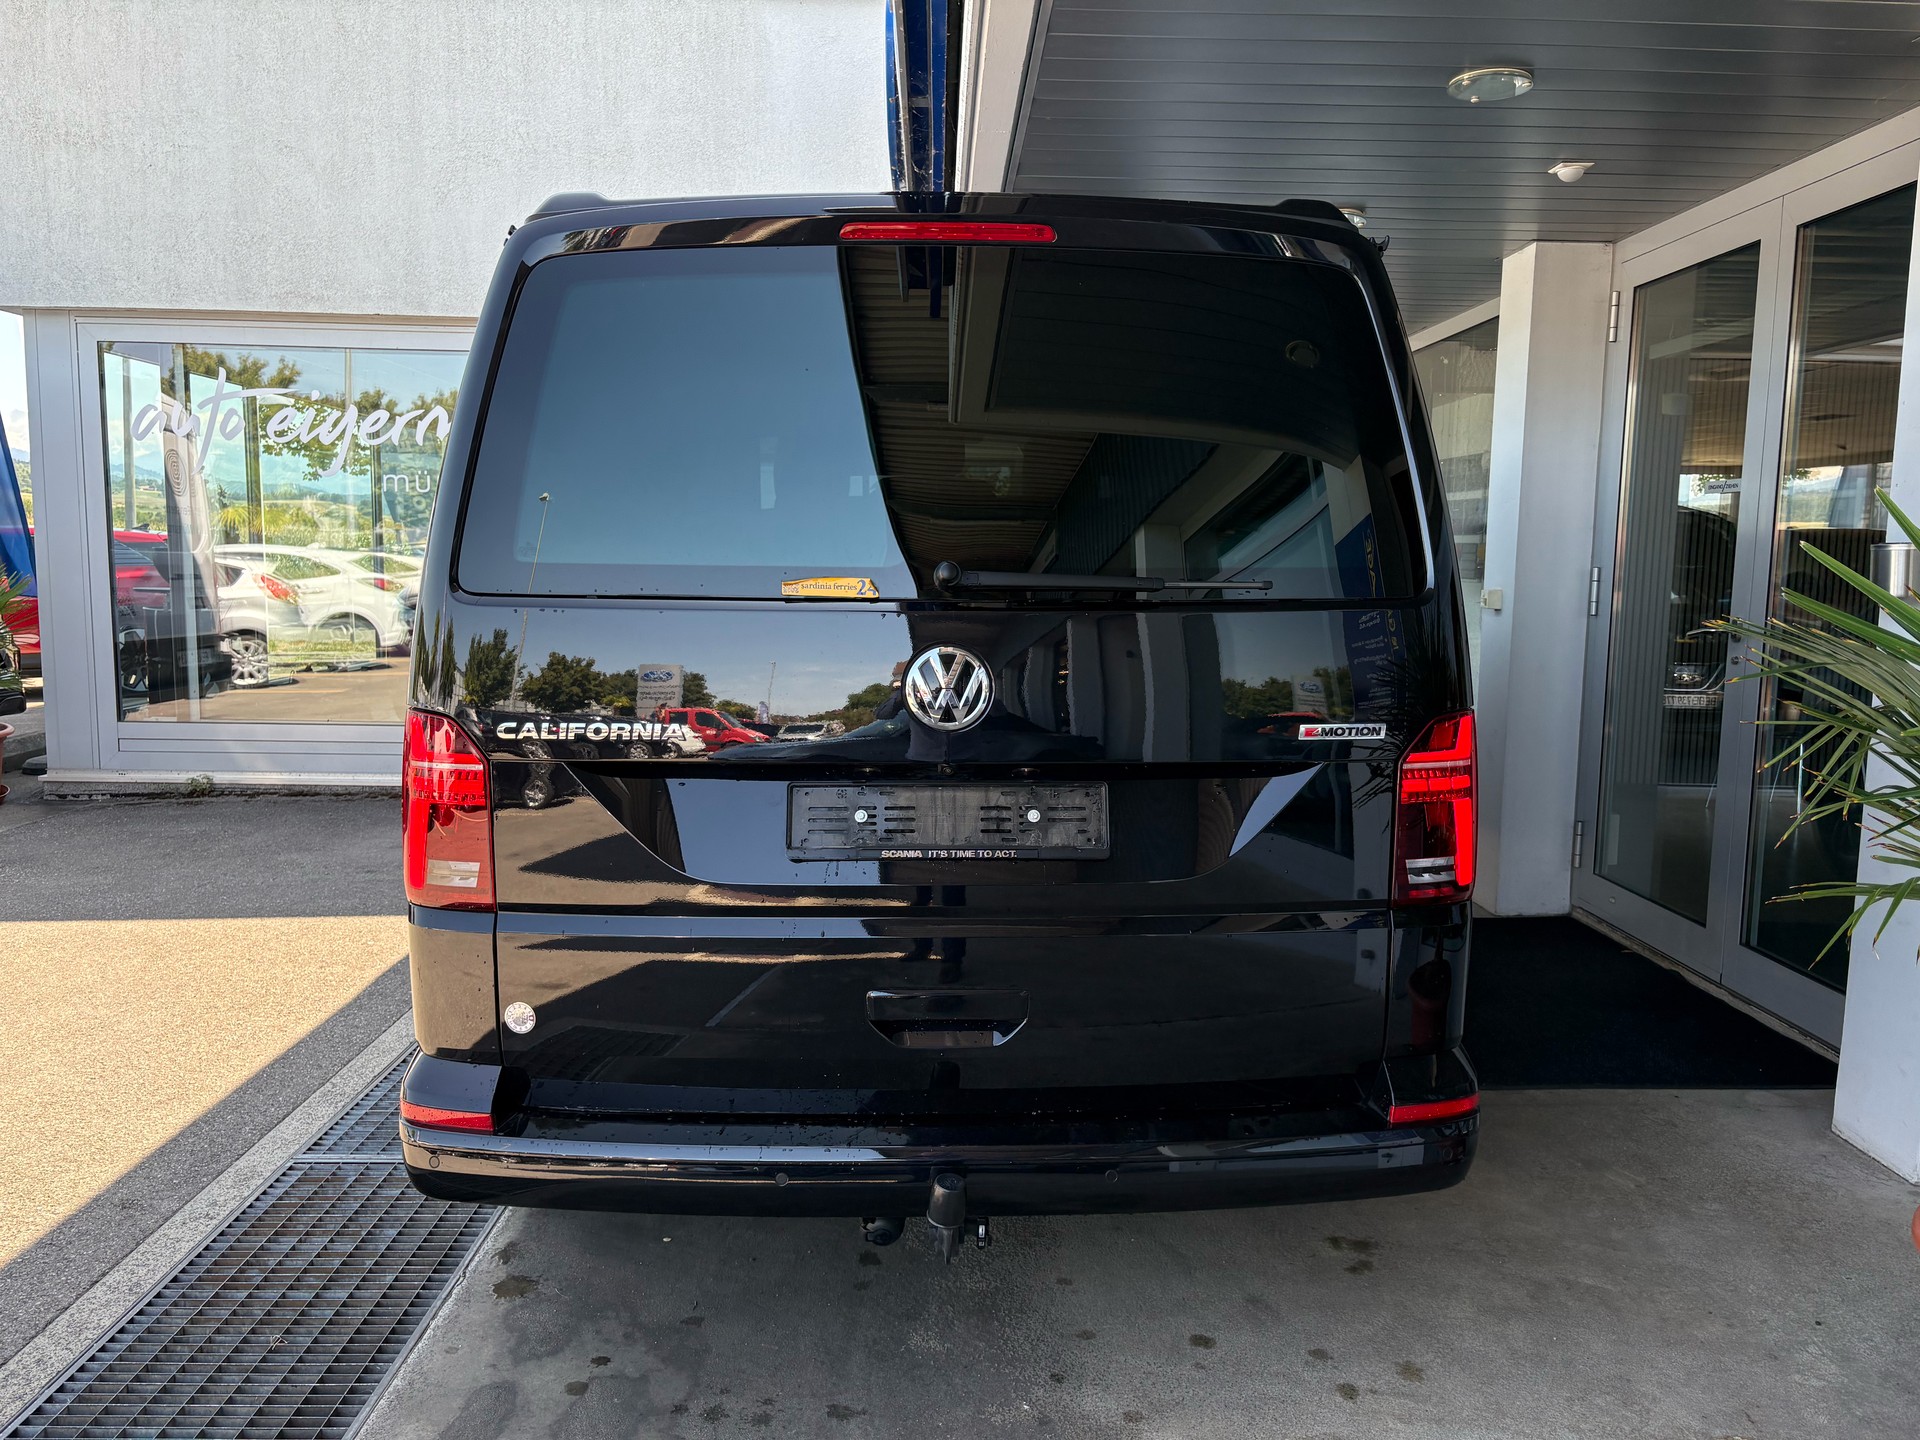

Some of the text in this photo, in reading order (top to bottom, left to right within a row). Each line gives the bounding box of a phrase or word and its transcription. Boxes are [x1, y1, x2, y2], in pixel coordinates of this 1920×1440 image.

[131, 367, 297, 476] auto
[800, 581, 833, 590] sardinia
[833, 582, 858, 591] ferries
[496, 721, 688, 741] CALIFORNIA
[1311, 726, 1382, 737] 4MOTION
[881, 849, 1018, 858] SCANIA IT'S TIME TO ACT.
